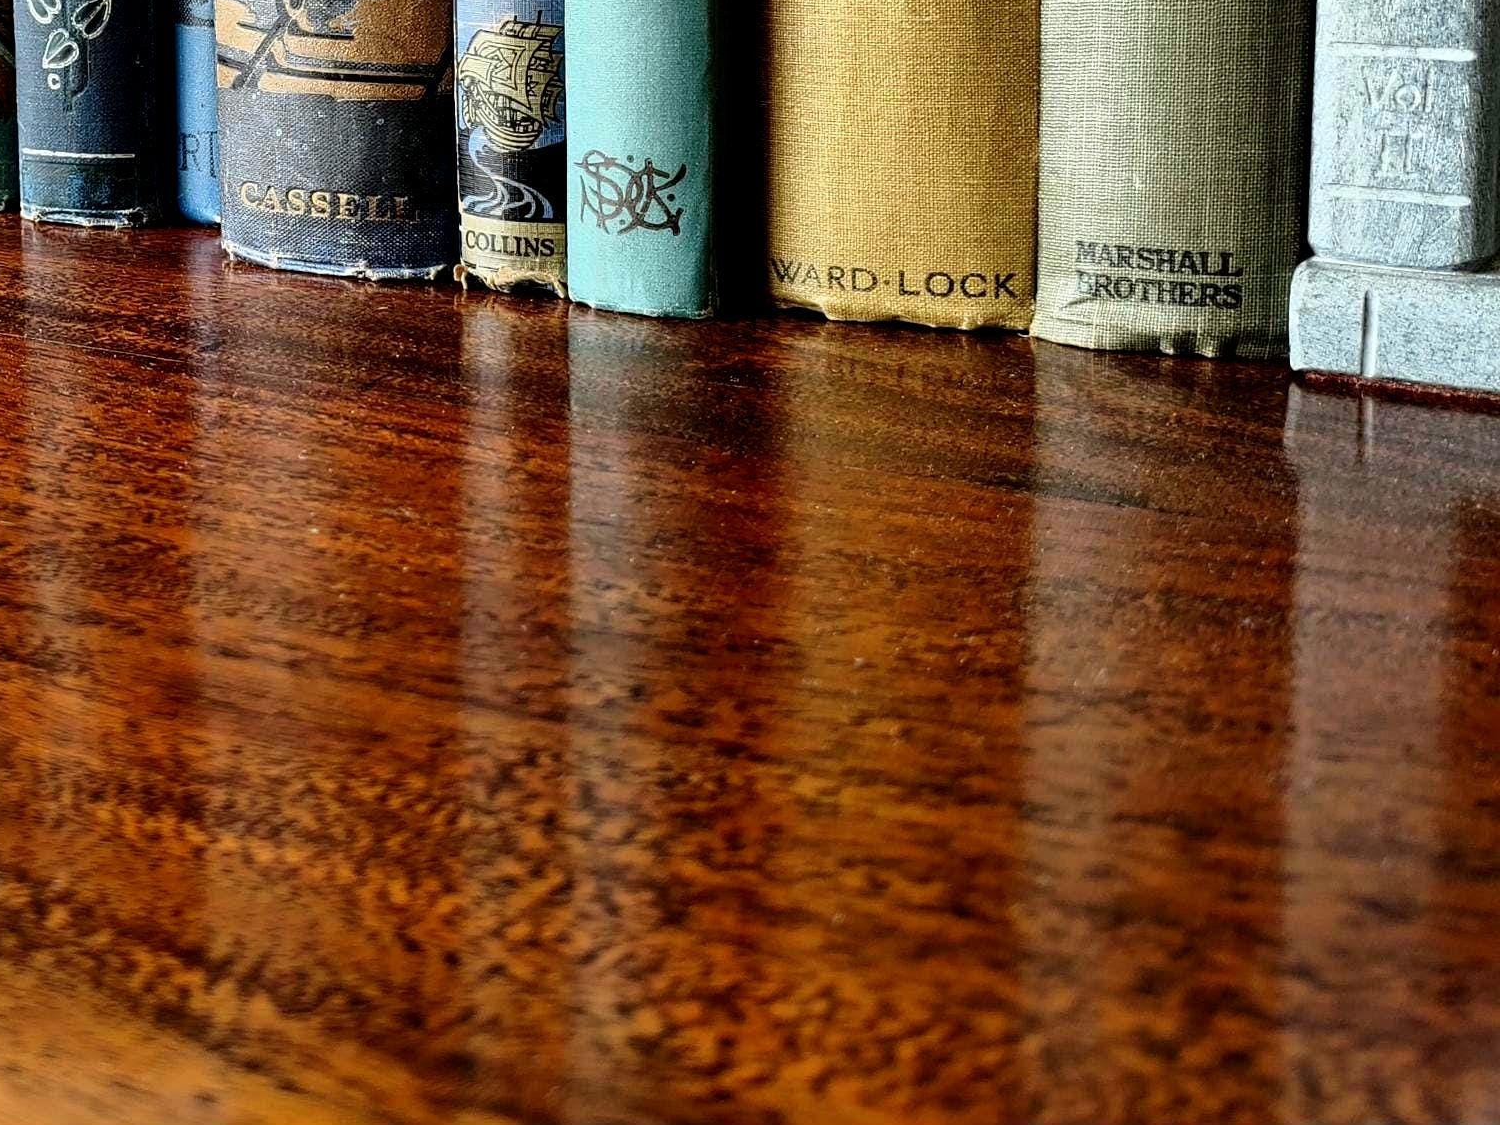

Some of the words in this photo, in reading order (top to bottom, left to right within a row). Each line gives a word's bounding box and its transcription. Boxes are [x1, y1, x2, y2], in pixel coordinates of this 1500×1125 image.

[465, 229, 556, 259] COLLINS
[1075, 240, 1244, 278] MARSHALL
[1075, 270, 1243, 310] BROTHERS
